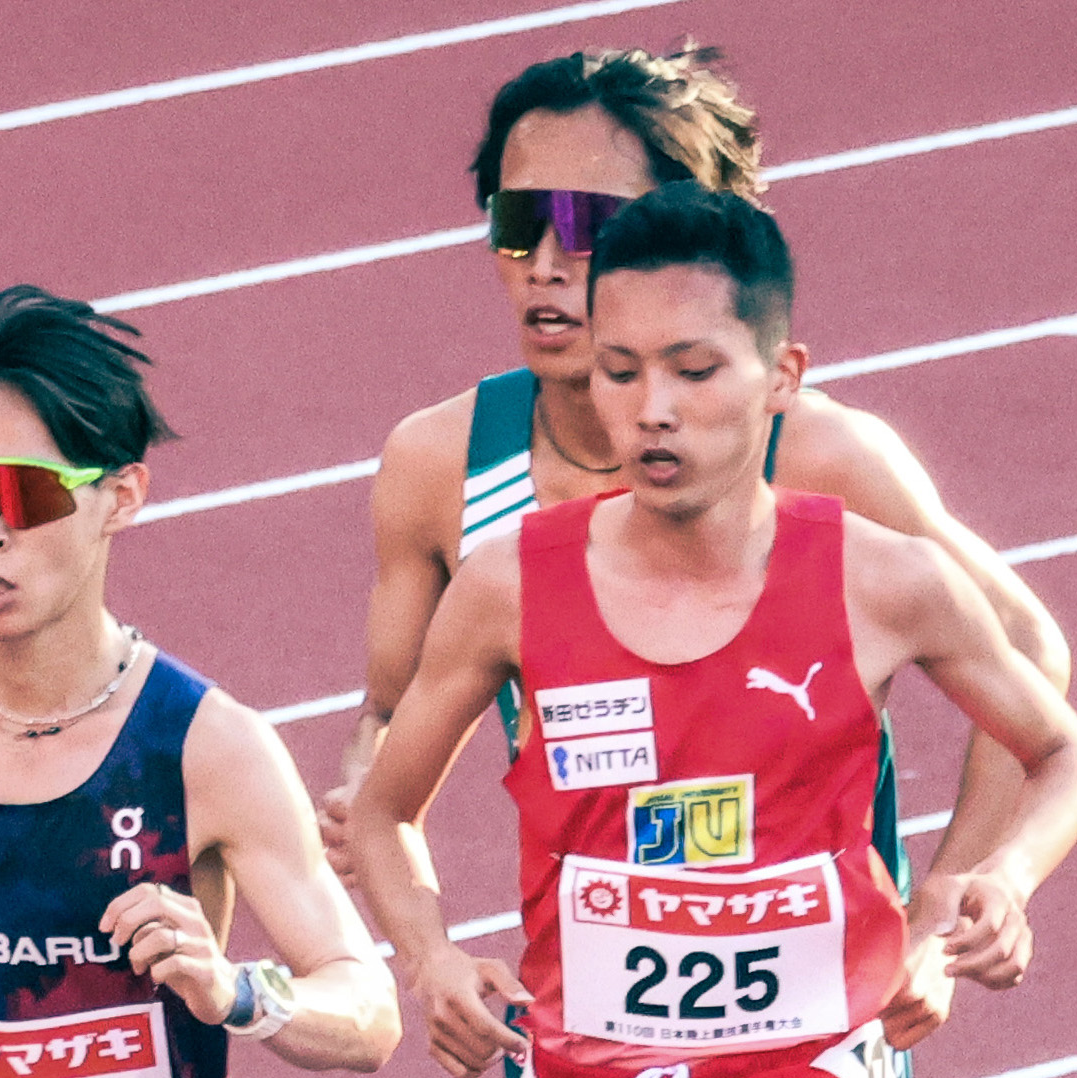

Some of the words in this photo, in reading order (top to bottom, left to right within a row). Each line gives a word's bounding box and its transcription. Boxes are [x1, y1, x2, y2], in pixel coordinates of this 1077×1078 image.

[576, 747, 649, 772] NITTA
[638, 884, 819, 926] ヤマザキ
[625, 945, 781, 1019] 225
